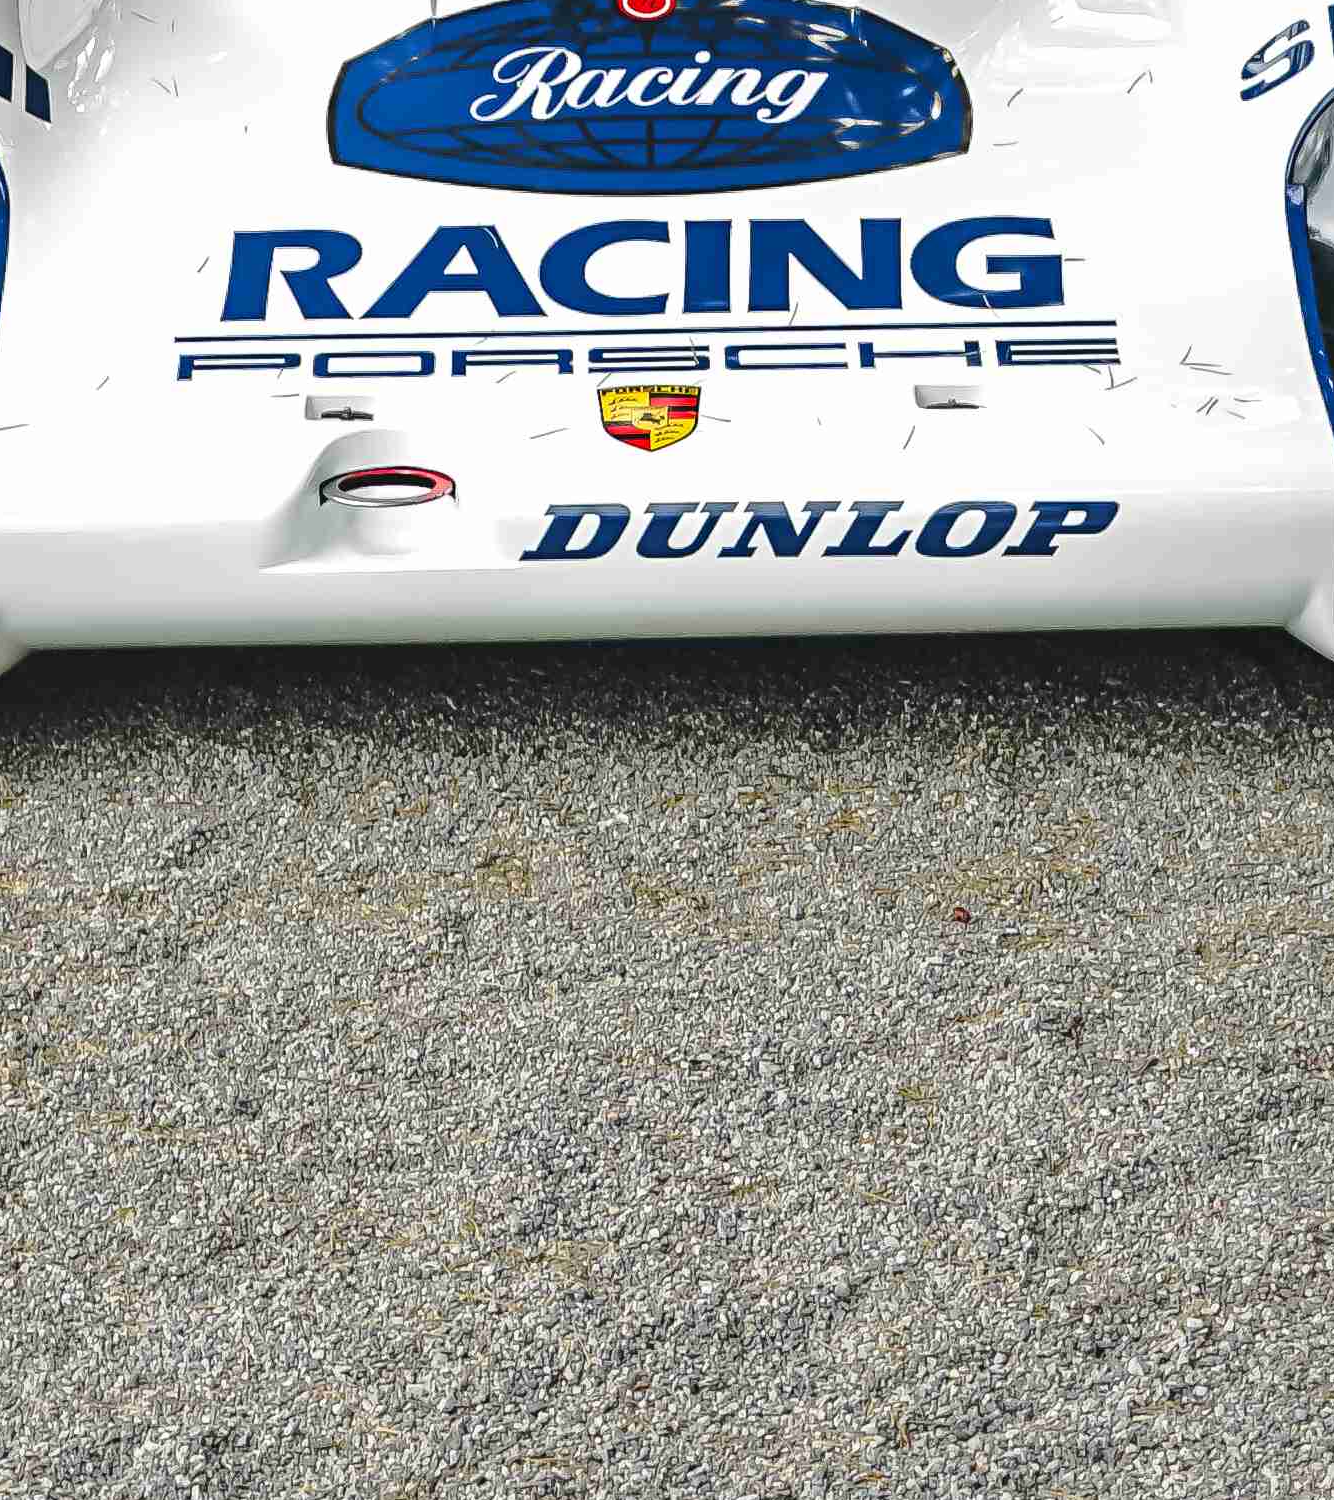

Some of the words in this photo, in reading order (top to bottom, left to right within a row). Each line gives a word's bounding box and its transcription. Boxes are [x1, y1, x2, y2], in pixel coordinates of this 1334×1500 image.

[468, 45, 829, 125] Racing
[219, 216, 1066, 322] RACING
[175, 337, 1122, 382] PORSCHE
[519, 500, 1120, 562] DUNLOP
